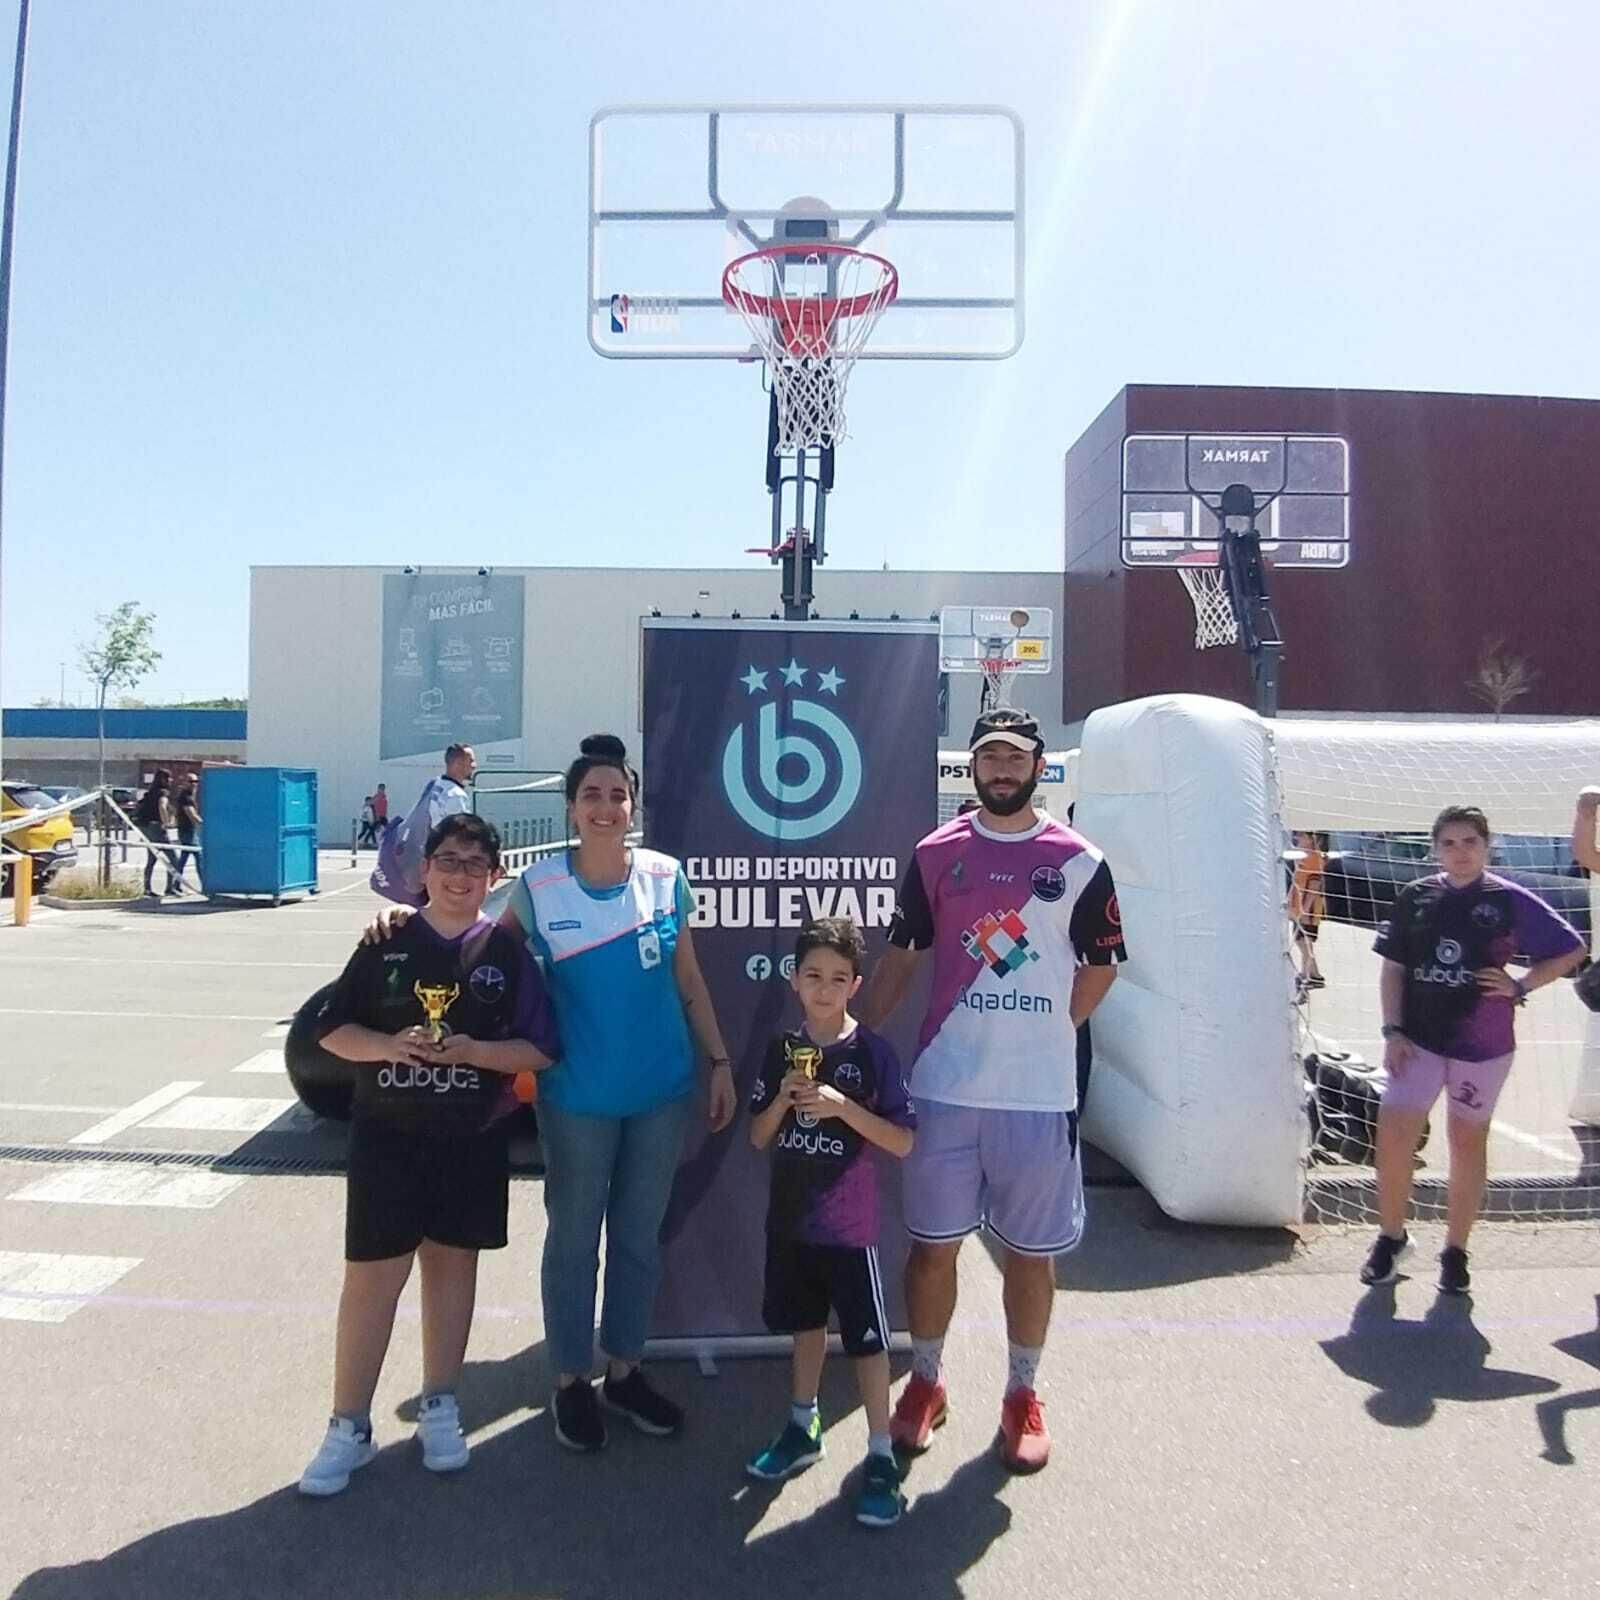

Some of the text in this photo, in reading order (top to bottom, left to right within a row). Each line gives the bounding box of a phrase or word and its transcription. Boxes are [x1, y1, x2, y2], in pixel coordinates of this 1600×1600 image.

[979, 613, 1010, 623] TARMA
[940, 765, 972, 779] PST
[686, 856, 897, 881] CLUB DEPORTIVO
[687, 886, 897, 929] BULEVAR
[957, 988, 1053, 1014] Aqadem
